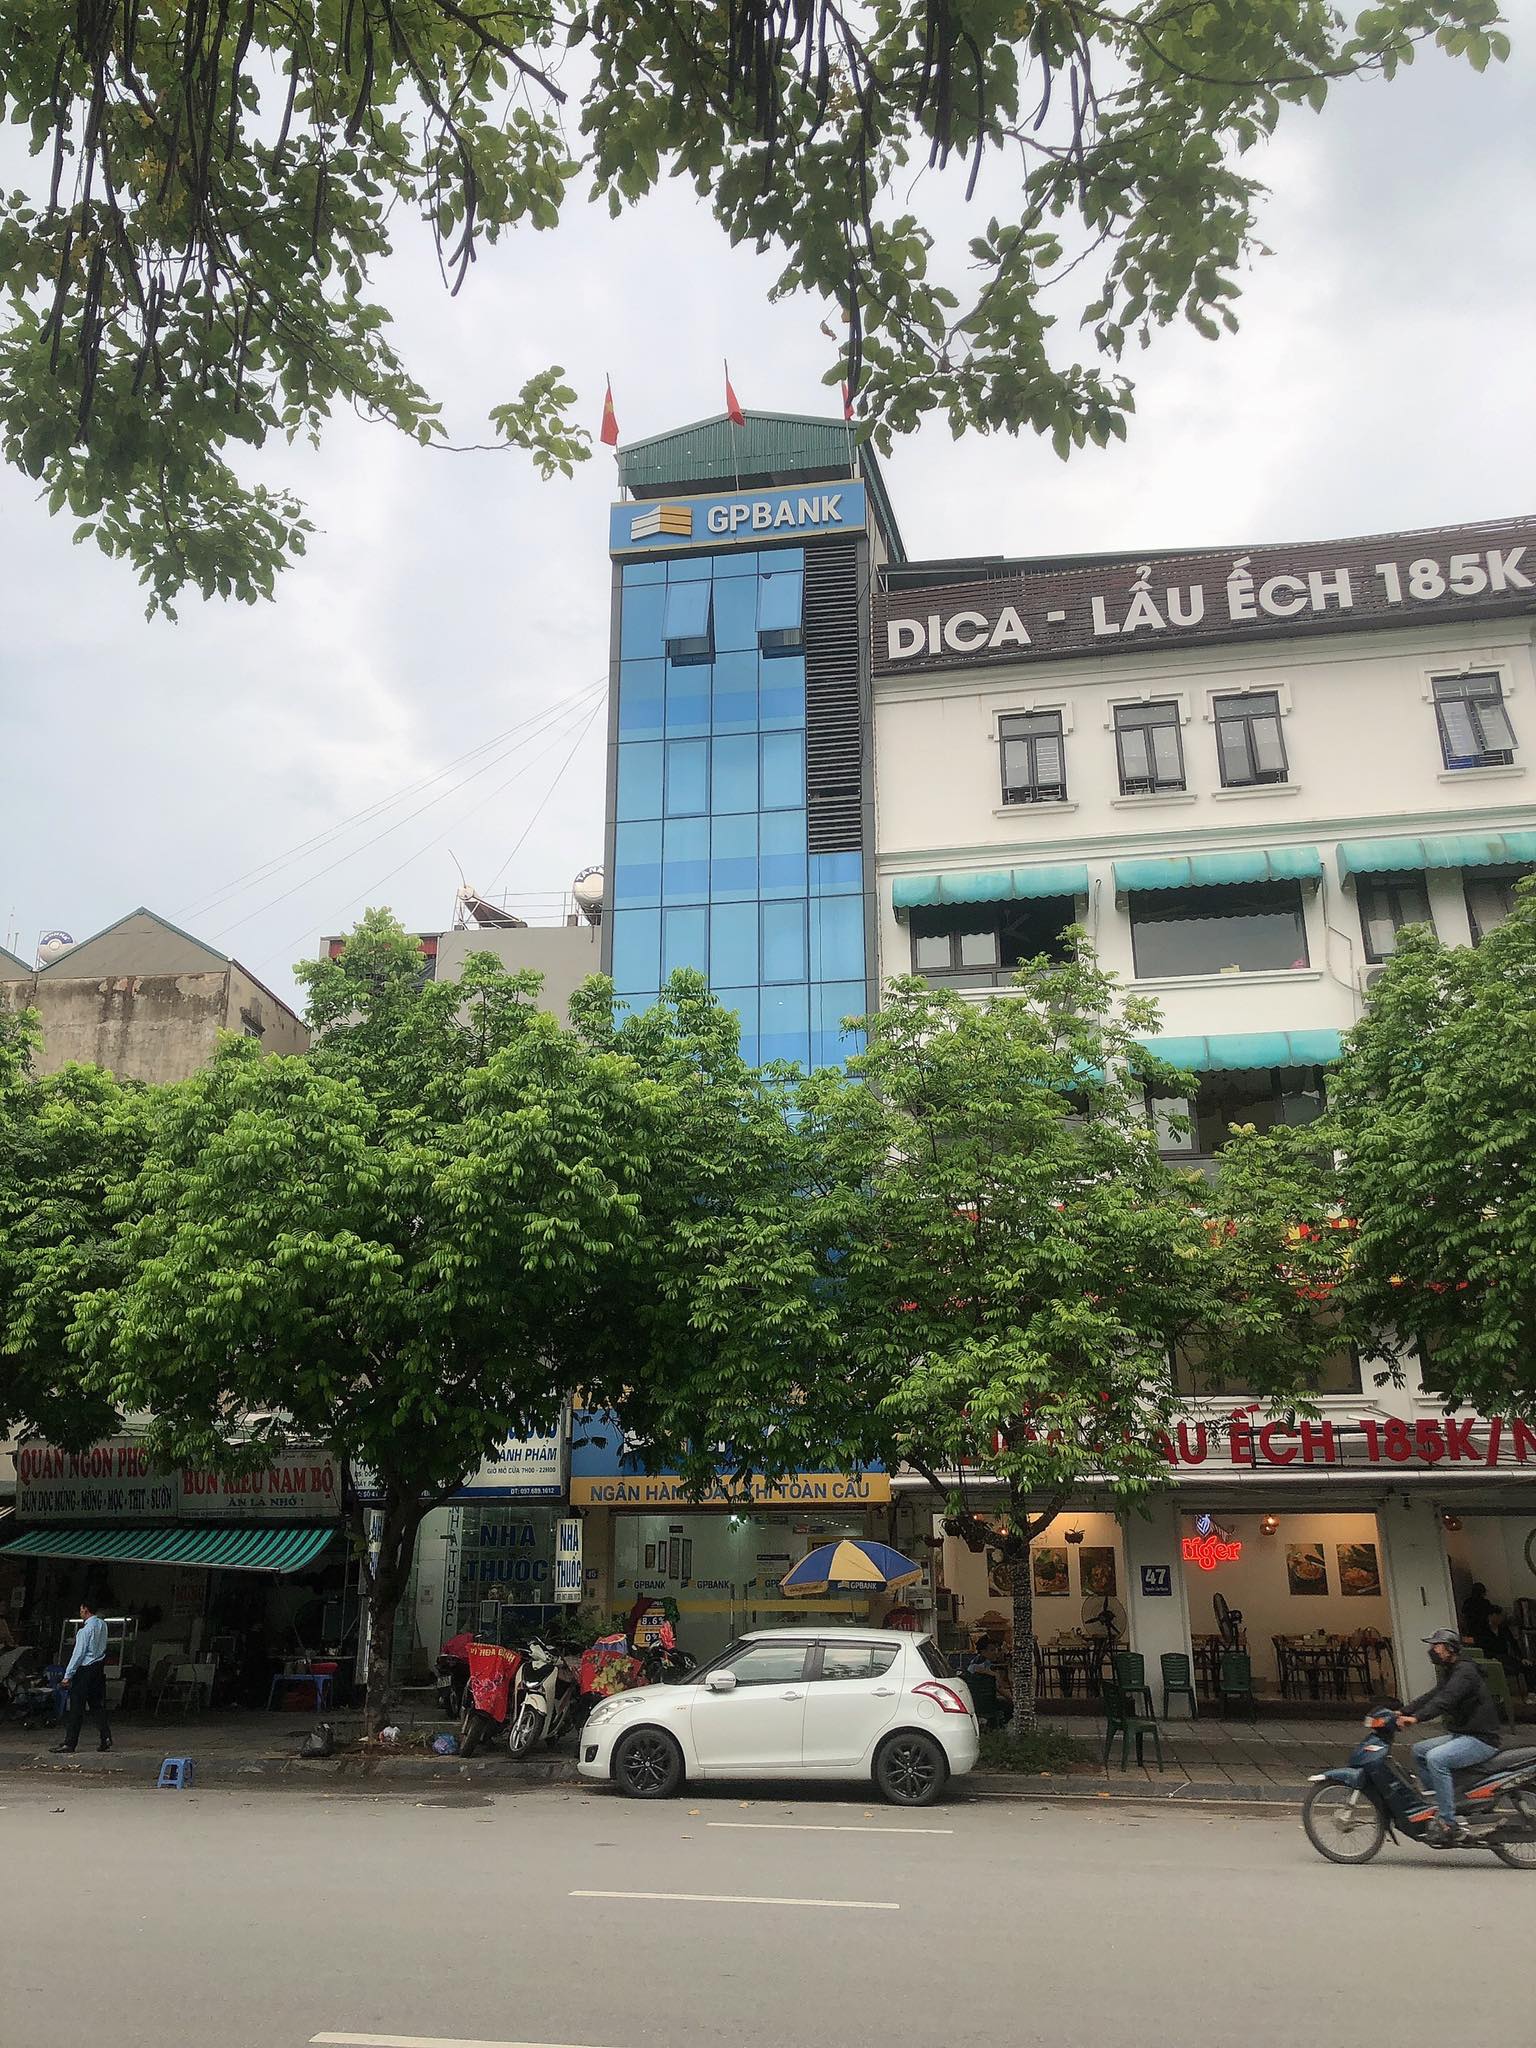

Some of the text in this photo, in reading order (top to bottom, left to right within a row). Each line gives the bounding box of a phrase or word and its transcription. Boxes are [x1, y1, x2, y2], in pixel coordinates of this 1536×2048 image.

[707, 494, 842, 533] GPBANK
[887, 605, 1032, 660] DICA
[1092, 565, 1205, 636] LẨU
[1227, 556, 1354, 621] ẾCH
[1376, 546, 1535, 603] 185K
[590, 1482, 640, 1502] NGÂN
[479, 1519, 537, 1548] NHÀ
[559, 1519, 580, 1552] NHÀ
[466, 1552, 549, 1582] THUỐC
[556, 1552, 582, 1588] THUỐC
[1145, 1568, 1167, 1585] 47
[633, 1580, 666, 1590] GPBANK
[697, 1580, 730, 1590] GPBANK
[850, 1581, 877, 1590] GPBANK
